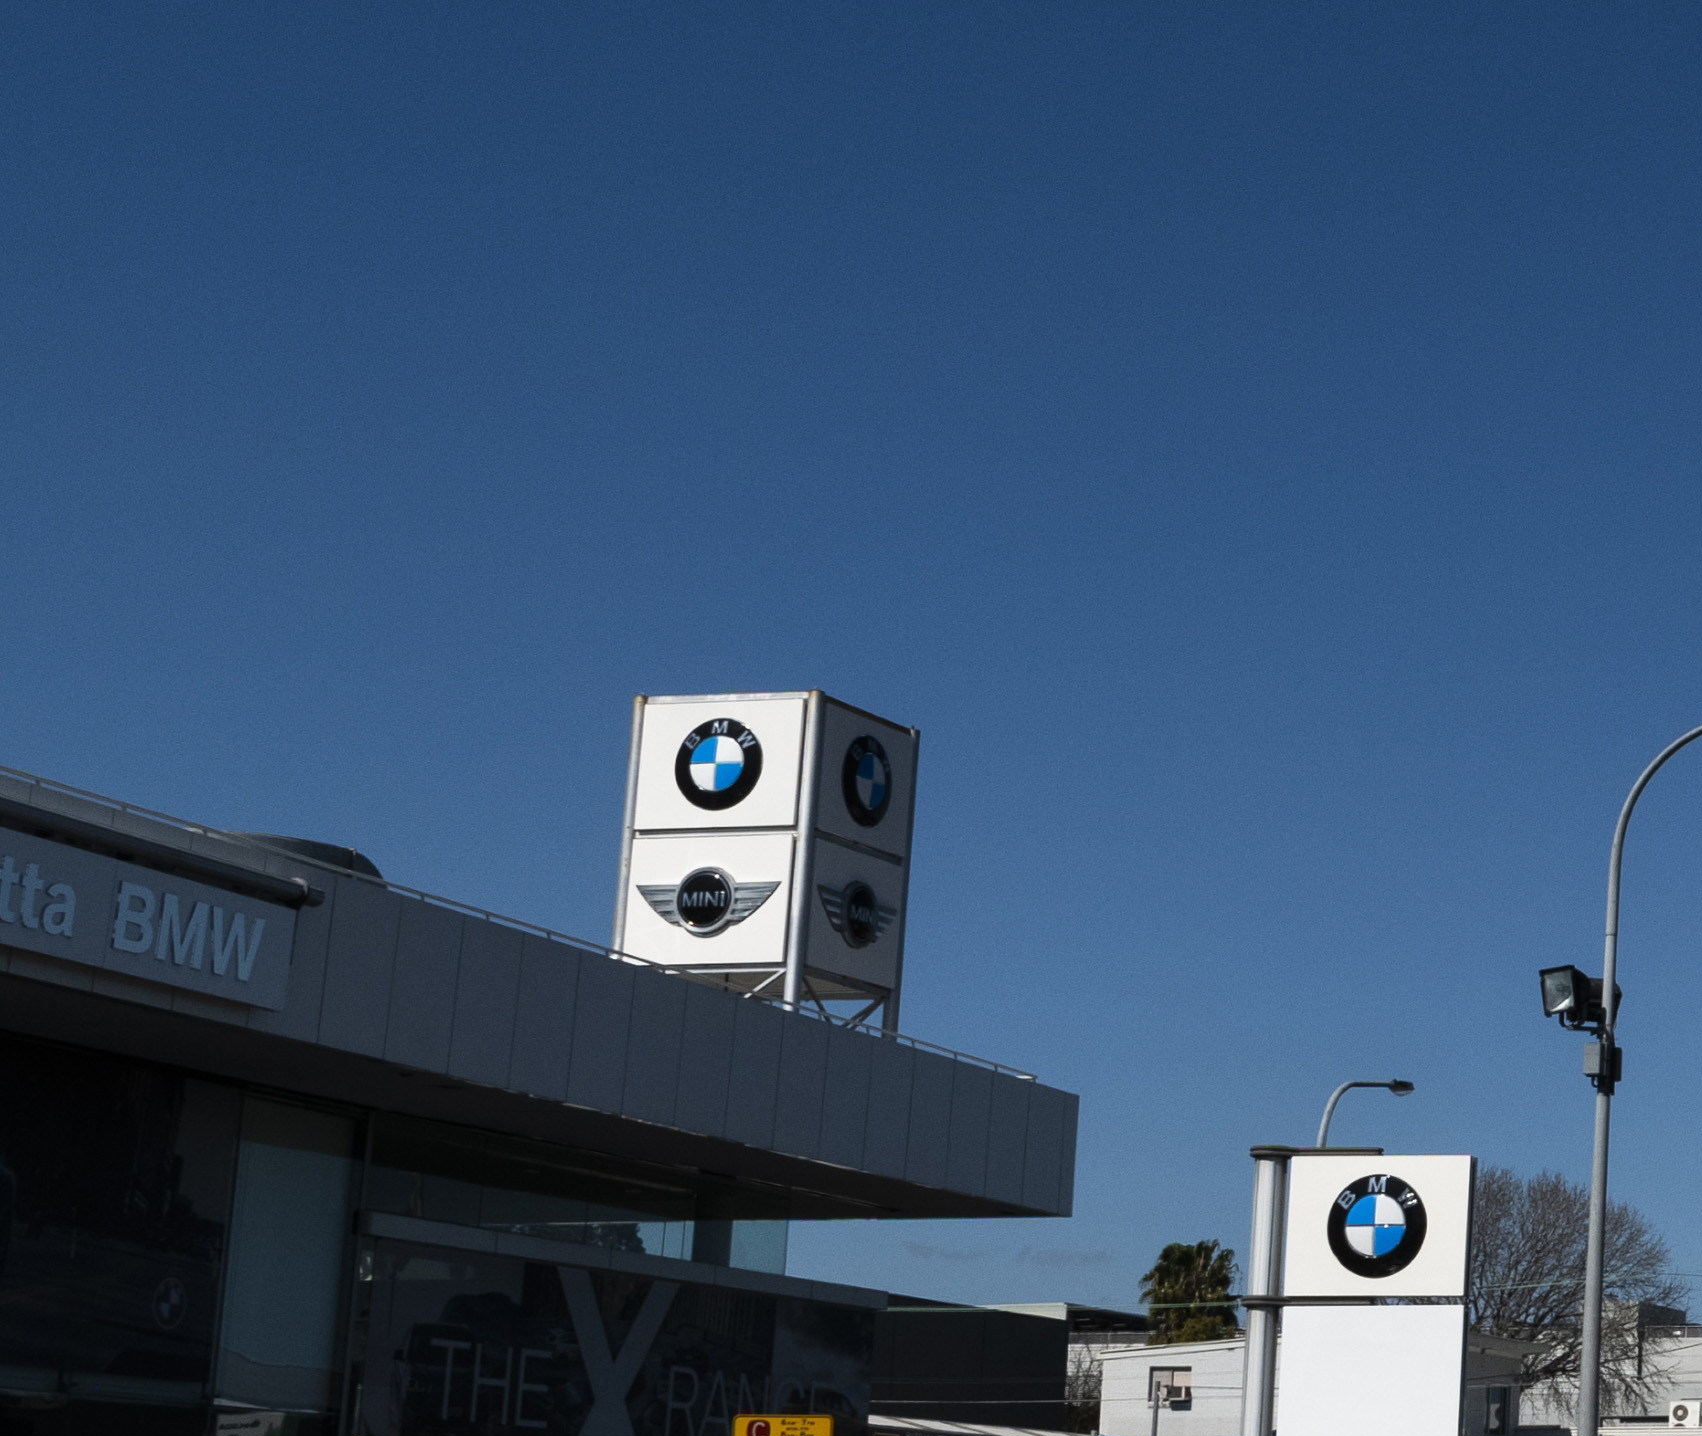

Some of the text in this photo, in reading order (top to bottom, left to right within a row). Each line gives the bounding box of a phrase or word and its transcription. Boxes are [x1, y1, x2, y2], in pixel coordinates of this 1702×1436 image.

[684, 720, 756, 750] BMW
[681, 891, 726, 908] MINI
[112, 880, 266, 982] BMW
[1337, 1175, 1417, 1209] BMW
[430, 1338, 554, 1430] THE
